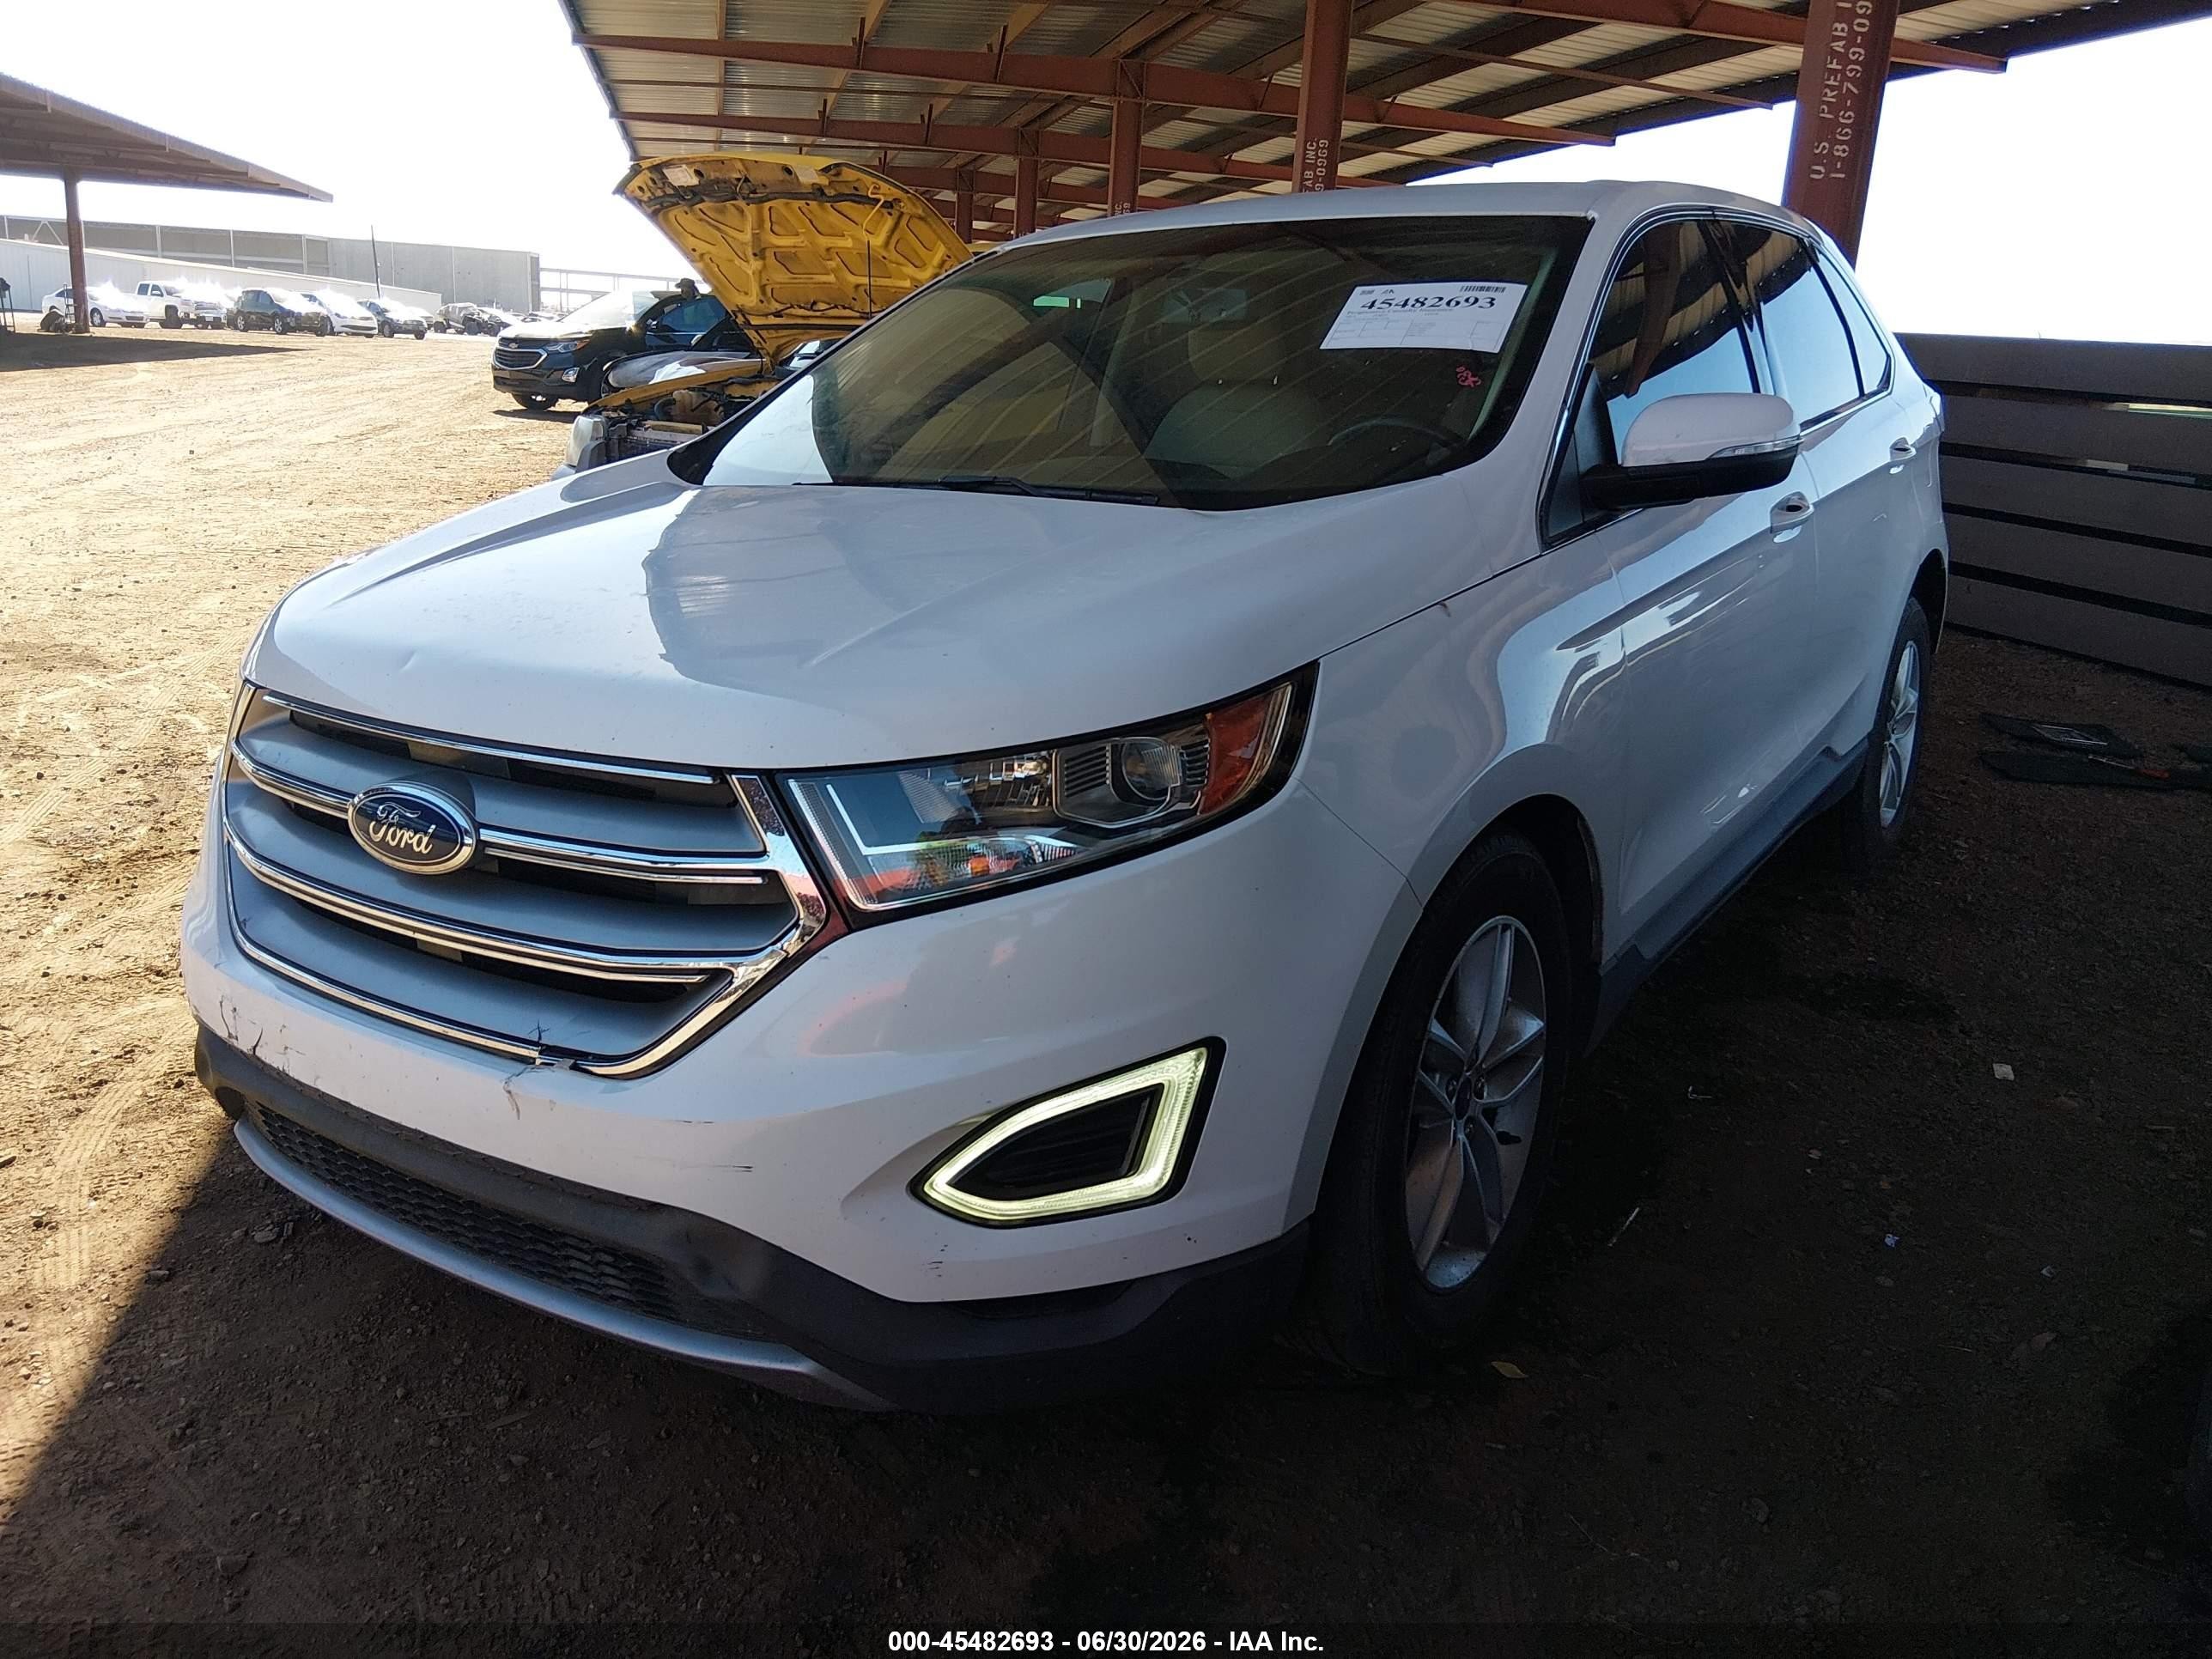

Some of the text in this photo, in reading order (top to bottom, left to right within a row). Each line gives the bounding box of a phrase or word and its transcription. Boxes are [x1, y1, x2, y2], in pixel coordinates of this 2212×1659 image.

[1819, 22, 1849, 118] PREFAB
[1305, 137, 1317, 163] INC.
[1809, 135, 1832, 179] U.S.
[1360, 295, 1497, 310] 45482693
[368, 801, 437, 854] Ford
